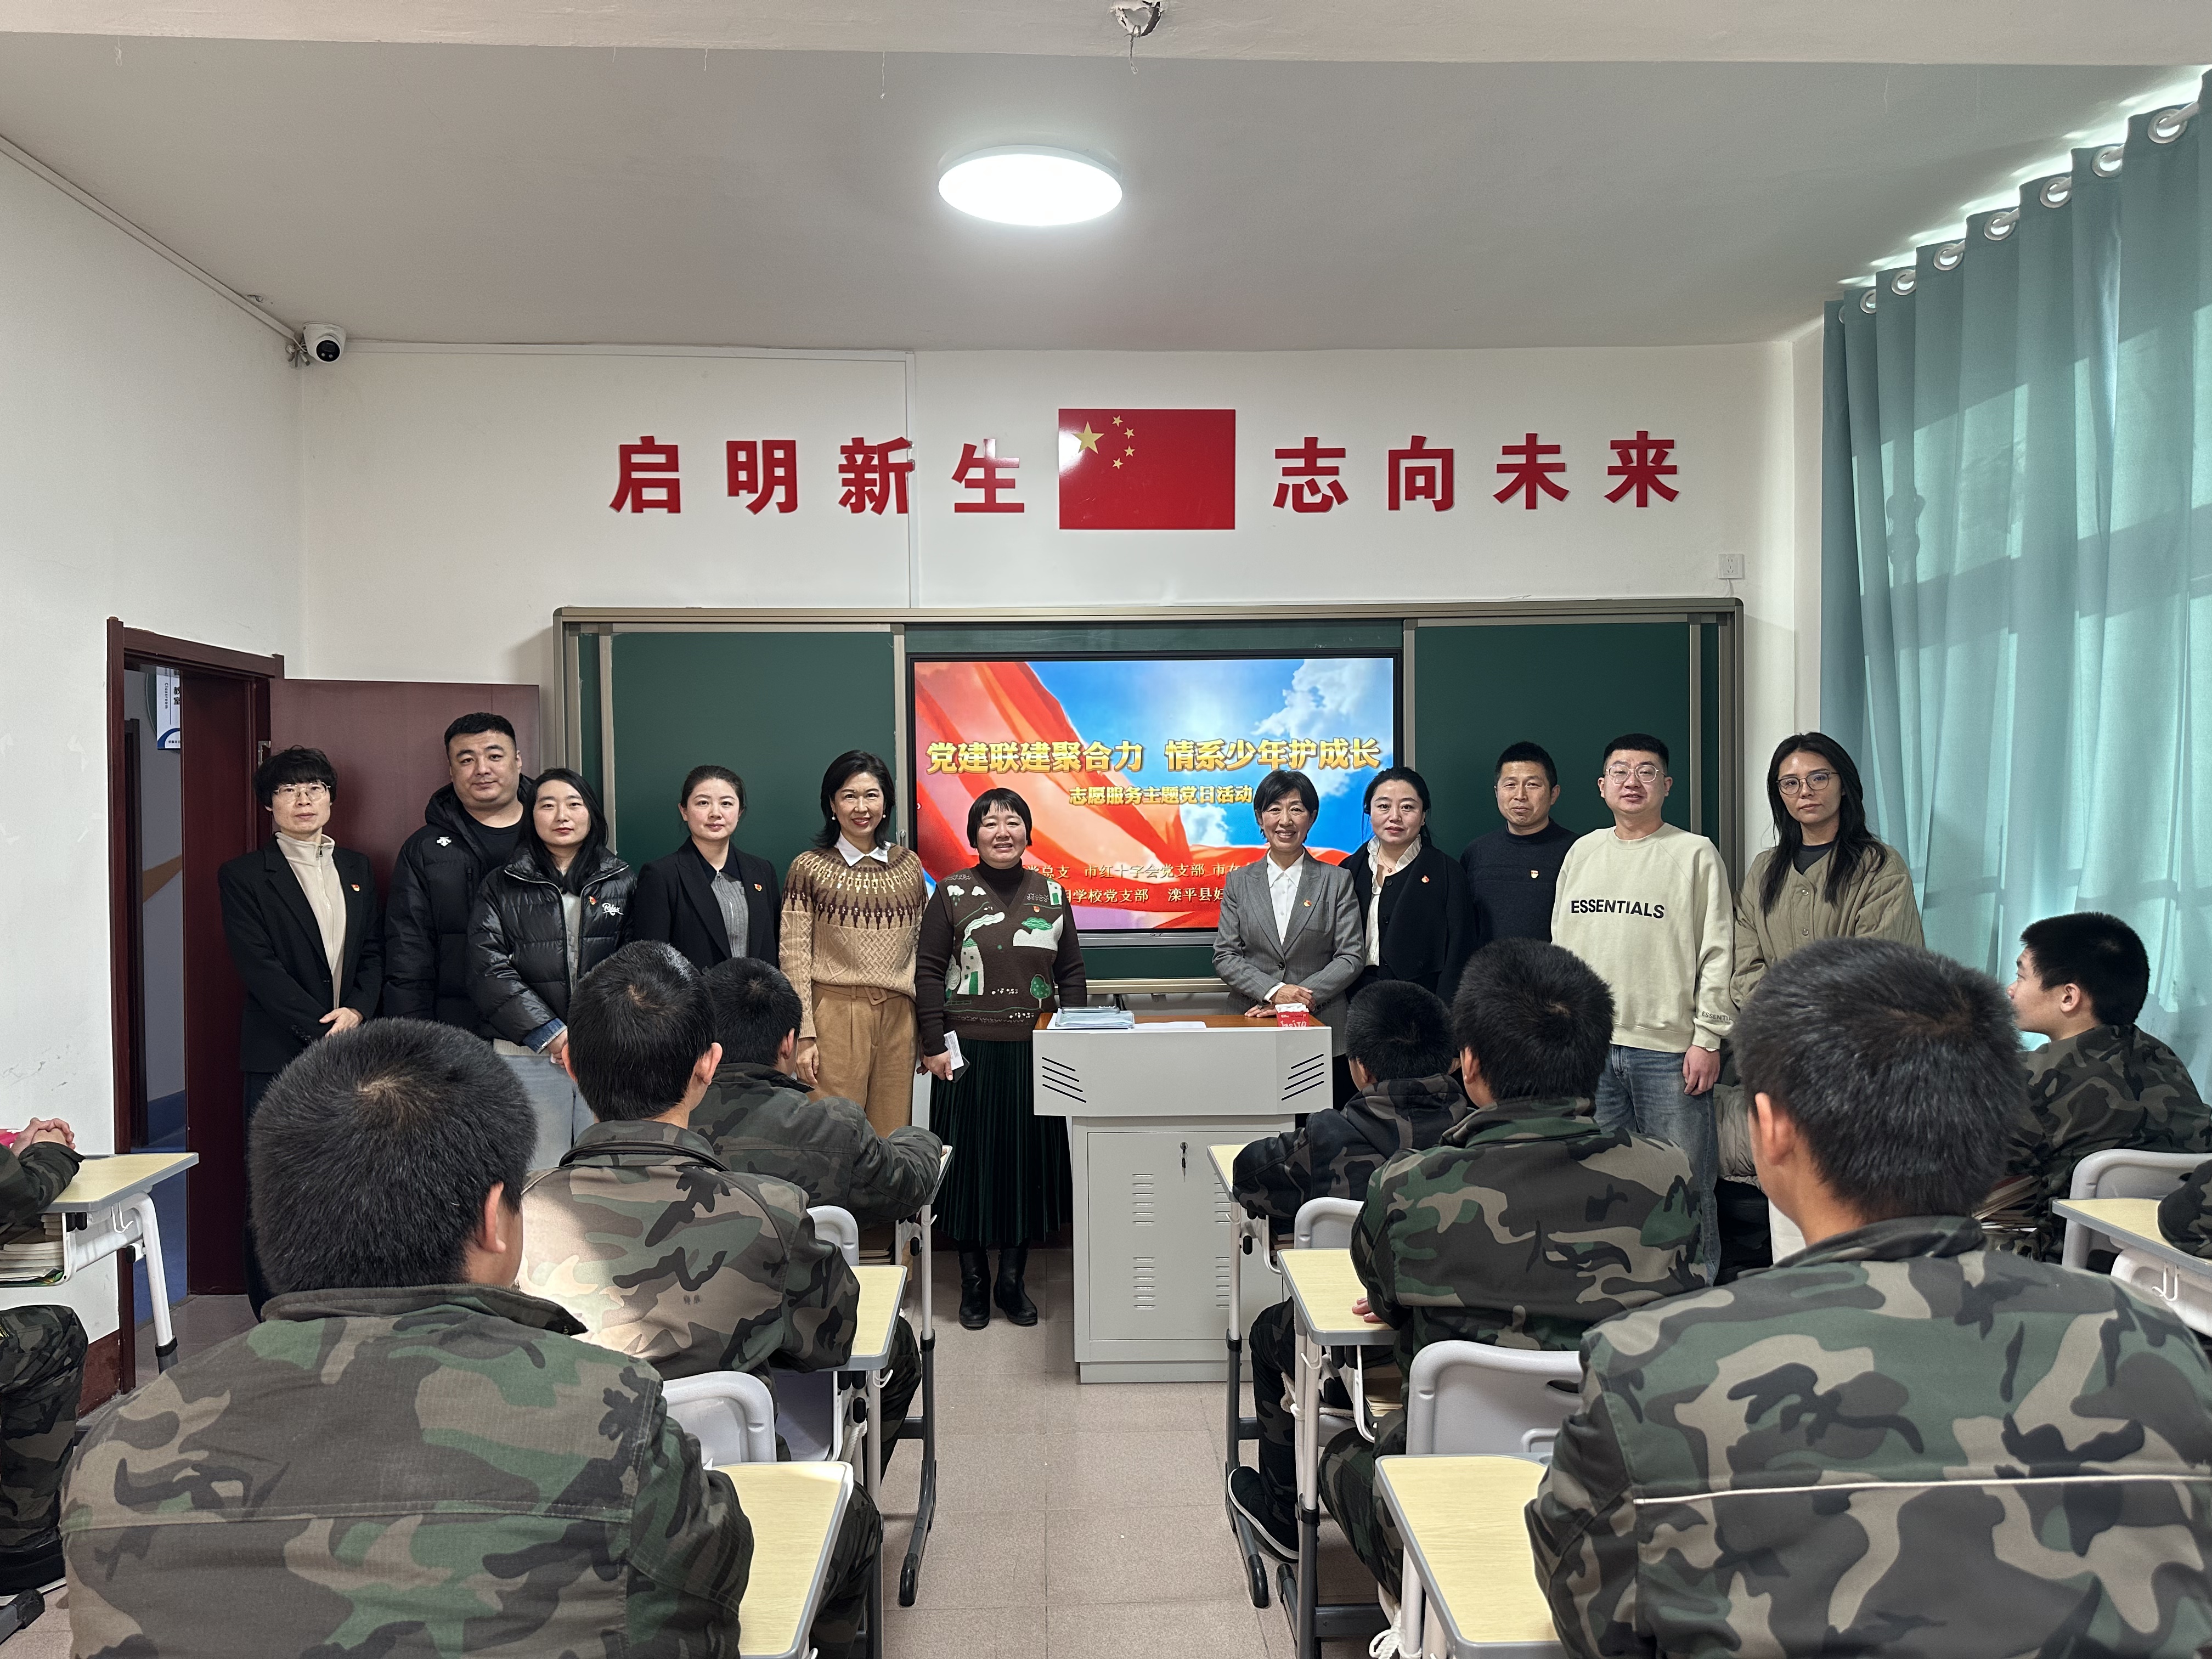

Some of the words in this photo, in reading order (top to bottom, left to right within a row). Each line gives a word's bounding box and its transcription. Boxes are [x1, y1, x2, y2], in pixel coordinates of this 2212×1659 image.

[610, 435, 1024, 515] 启明新生
[1273, 431, 1679, 513] 志向未来
[926, 740, 1144, 774] 党建联建聚合力
[1164, 737, 1380, 770] 情系少年护成长
[1069, 785, 1253, 805] 志愿服务主题党日活动
[1084, 863, 1205, 879] 市红十字会党支部
[1571, 899, 1665, 919] ESSENTIALS
[1702, 1011, 1732, 1021] ESSENTI
